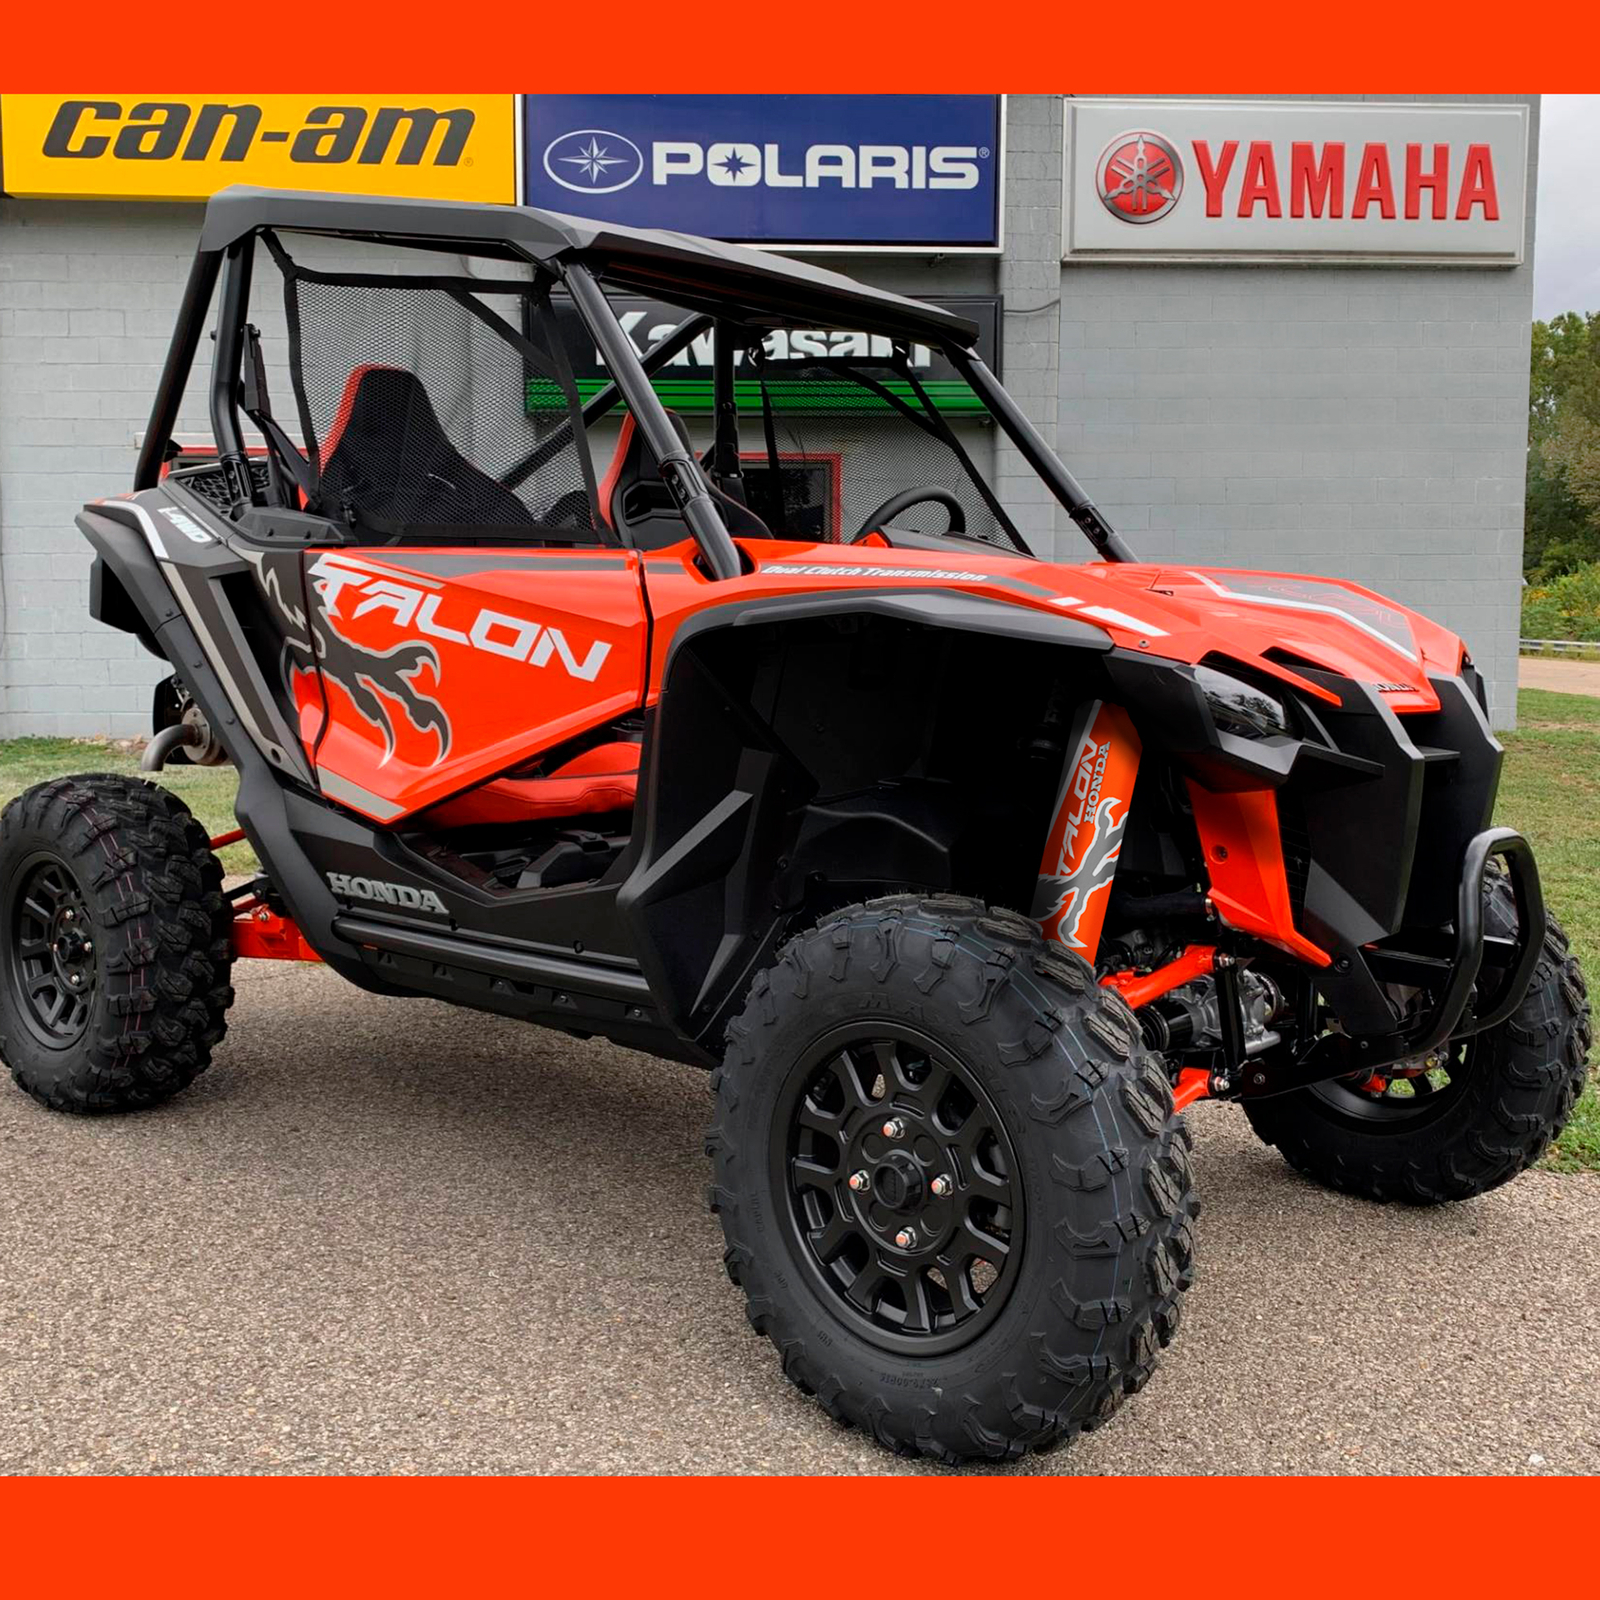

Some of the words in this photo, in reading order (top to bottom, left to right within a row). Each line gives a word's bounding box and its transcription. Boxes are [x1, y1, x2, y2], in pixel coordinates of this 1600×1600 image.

[42, 100, 476, 167] can-am
[652, 141, 980, 190] POLARIS
[1191, 139, 1500, 221] YAMAHA
[761, 565, 803, 575] Dual
[803, 566, 863, 576] Clutch
[862, 567, 988, 582] Transmission
[307, 552, 613, 683] TALON
[1055, 735, 1098, 878] TALON
[1083, 741, 1111, 824] HONDA
[326, 871, 450, 915] HONDA
